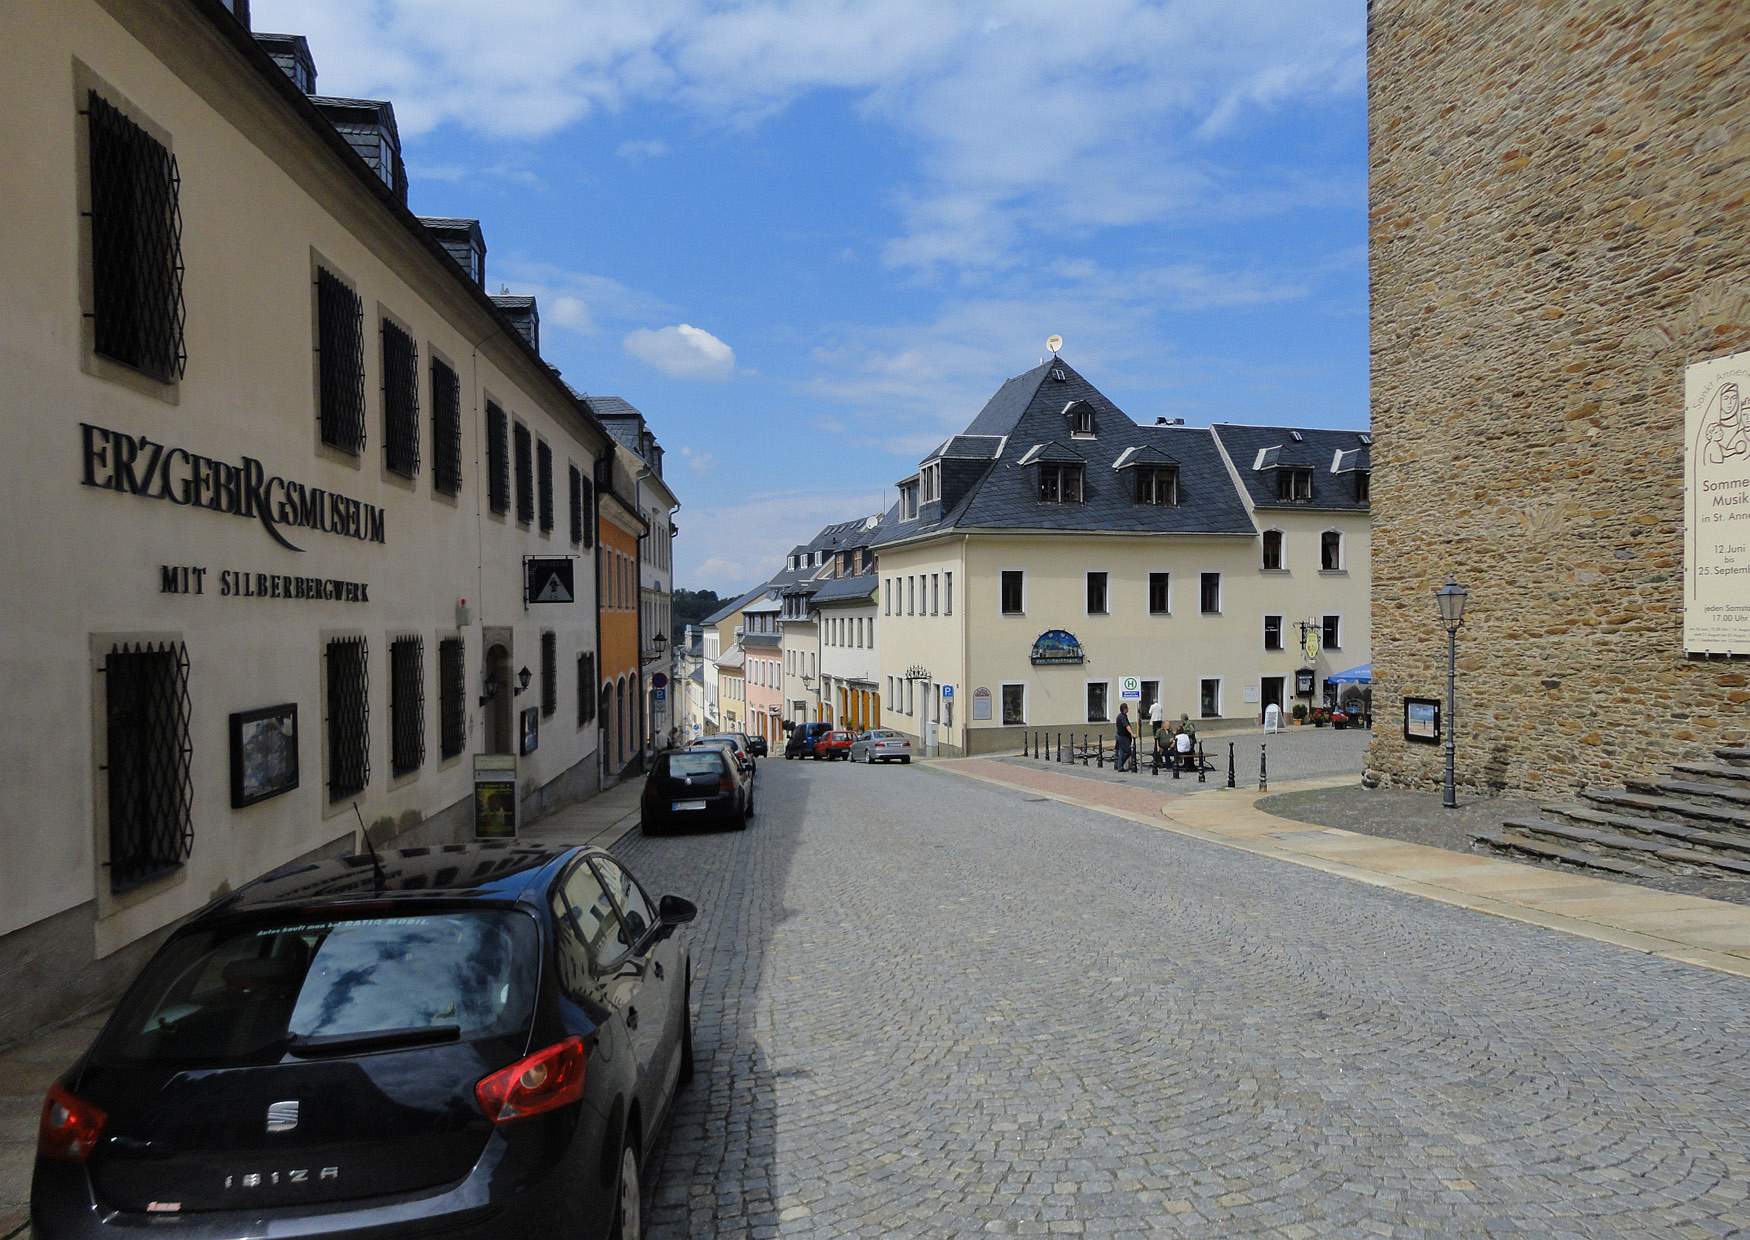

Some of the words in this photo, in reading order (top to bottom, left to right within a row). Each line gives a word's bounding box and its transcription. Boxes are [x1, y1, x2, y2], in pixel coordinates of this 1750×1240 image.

[79, 423, 386, 552] ERZGEBIRGSMUSEUM
[1712, 491, 1750, 507] Musik
[1702, 514, 1711, 522] in
[1724, 556, 1735, 564] bis
[160, 565, 207, 594] MIT
[221, 570, 369, 602] SILBERBERGWERK
[224, 1166, 338, 1189] IBIZA
